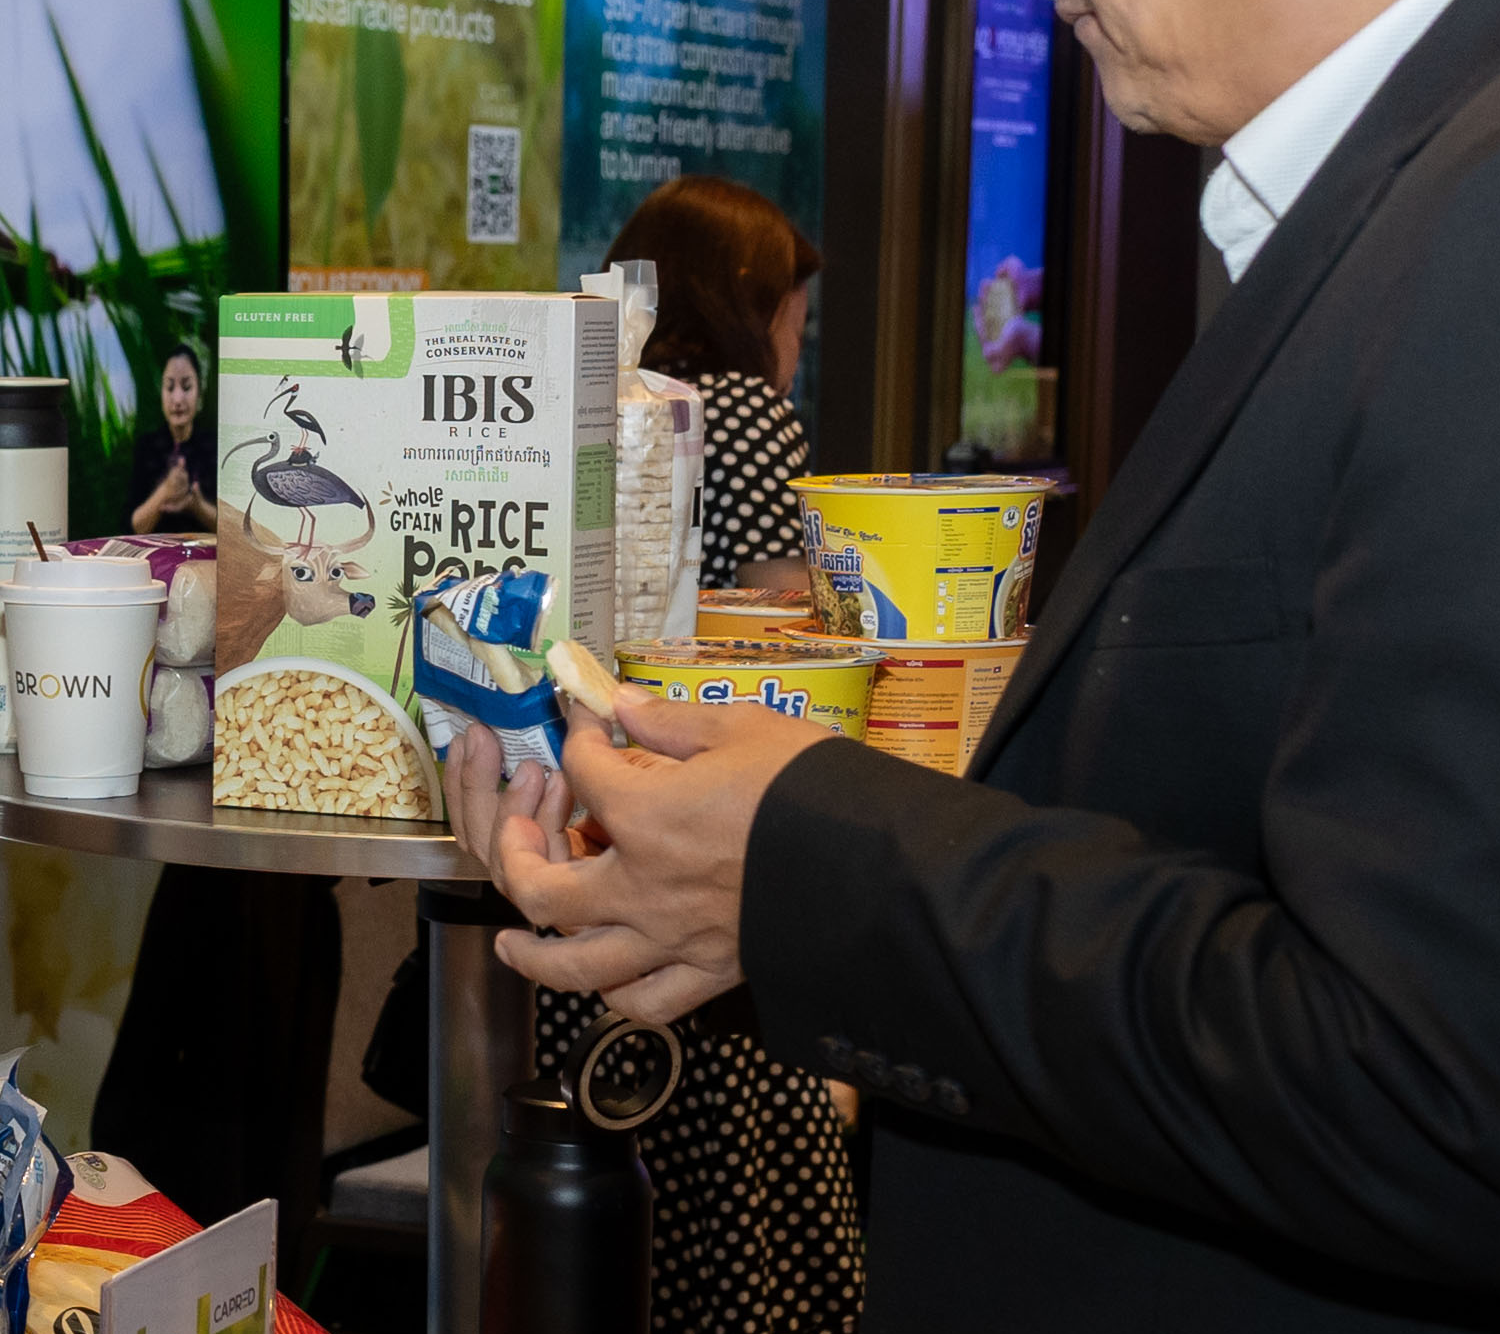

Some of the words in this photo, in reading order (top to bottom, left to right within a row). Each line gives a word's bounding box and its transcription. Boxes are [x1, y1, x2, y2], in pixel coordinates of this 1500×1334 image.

[410, 3, 496, 44] products
[234, 312, 281, 323] GLUTEN
[285, 312, 315, 323] FREE
[425, 337, 446, 346] THE
[449, 335, 475, 344] REAL
[479, 335, 511, 345] TASTE
[514, 338, 528, 348] OF
[426, 346, 525, 359] CONSERVATION
[422, 374, 535, 424] IBIS
[449, 426, 507, 438] RICE
[451, 500, 549, 557] RICE
[16, 670, 111, 699] BROWN
